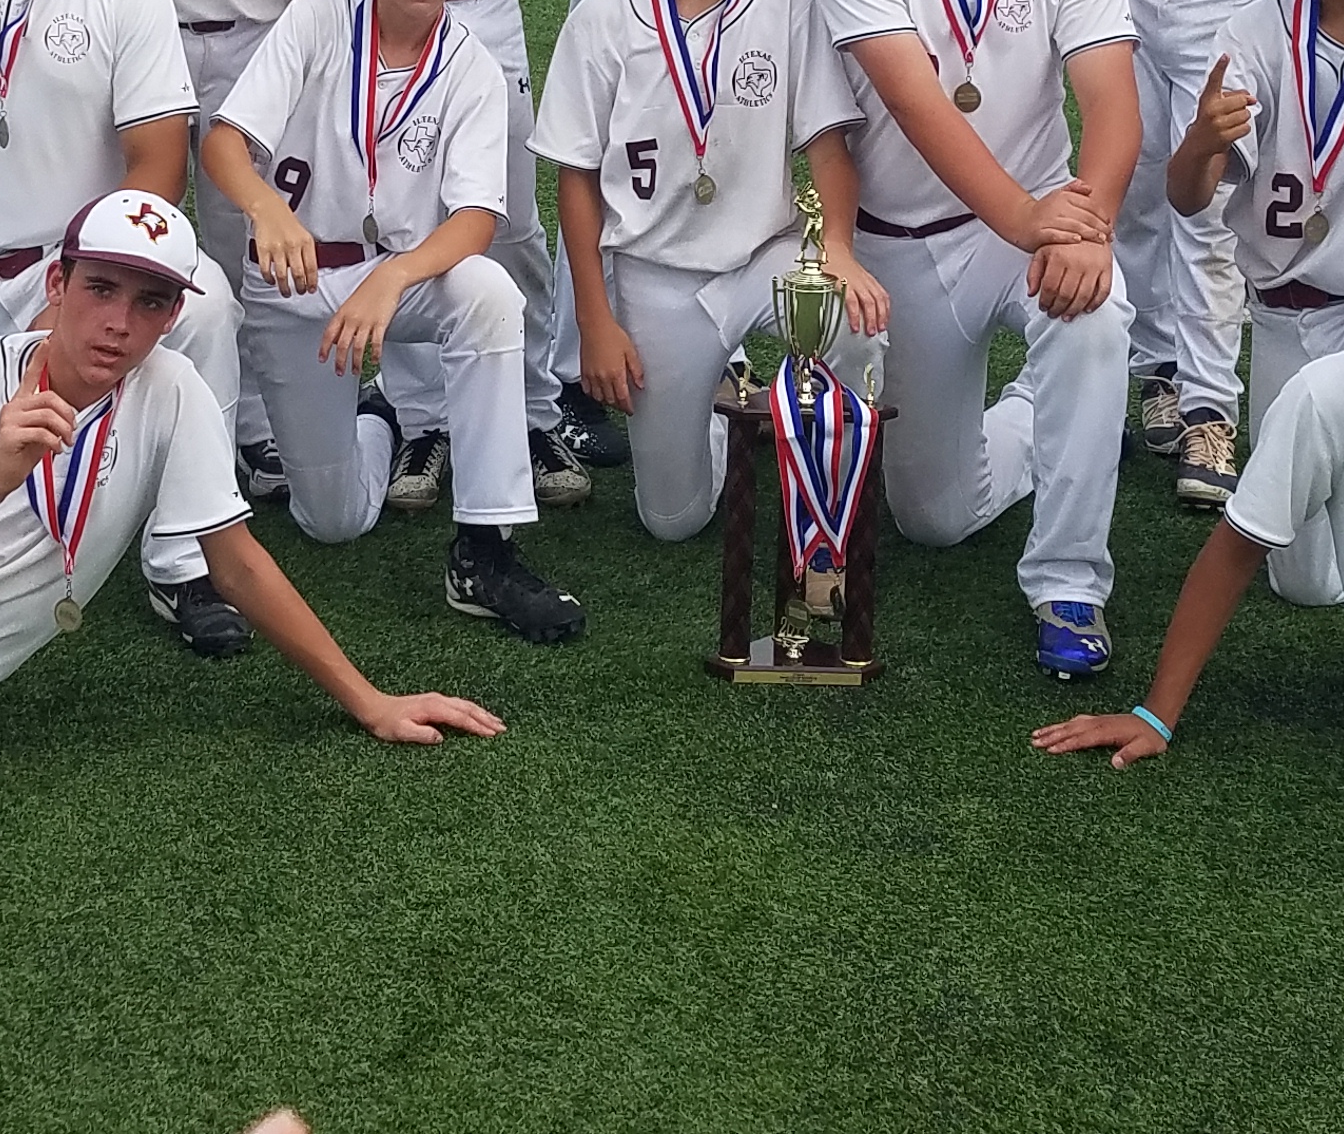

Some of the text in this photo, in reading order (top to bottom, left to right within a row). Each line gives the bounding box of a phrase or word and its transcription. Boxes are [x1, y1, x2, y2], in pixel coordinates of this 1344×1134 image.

[736, 92, 773, 107] ATHLETICS
[274, 156, 312, 213] 9
[626, 138, 659, 200] 5
[1266, 172, 1304, 239] 2
